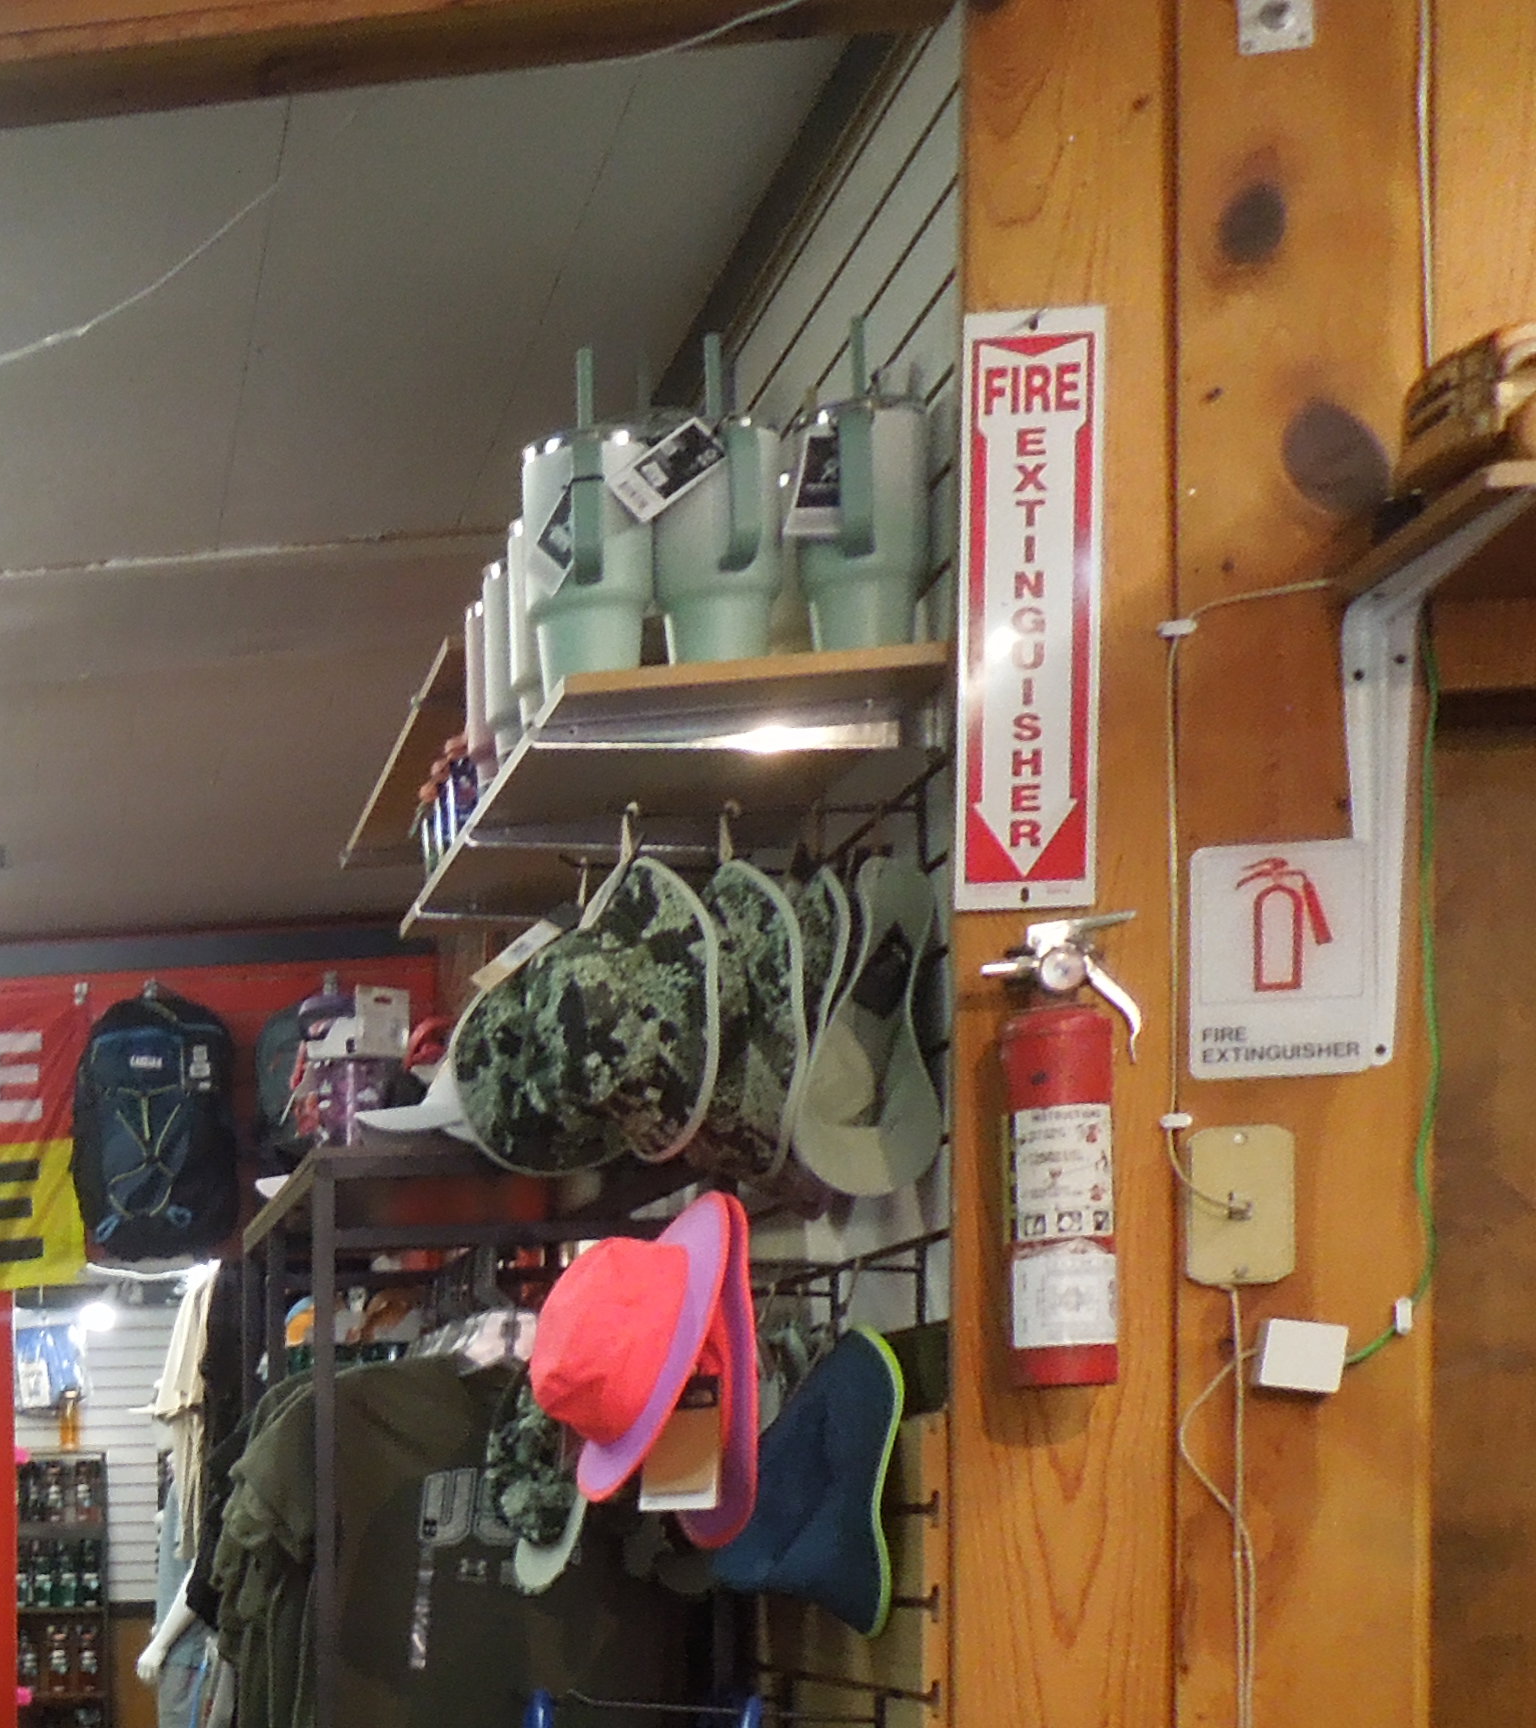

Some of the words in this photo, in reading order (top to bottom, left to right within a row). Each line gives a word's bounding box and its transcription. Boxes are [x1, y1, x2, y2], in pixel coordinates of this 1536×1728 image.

[984, 362, 1081, 415] FIRE
[1009, 427, 1047, 848] EXTINGUISHER
[1202, 1026, 1248, 1042] FIRE
[1202, 1041, 1360, 1064] EXTINGUISHER
